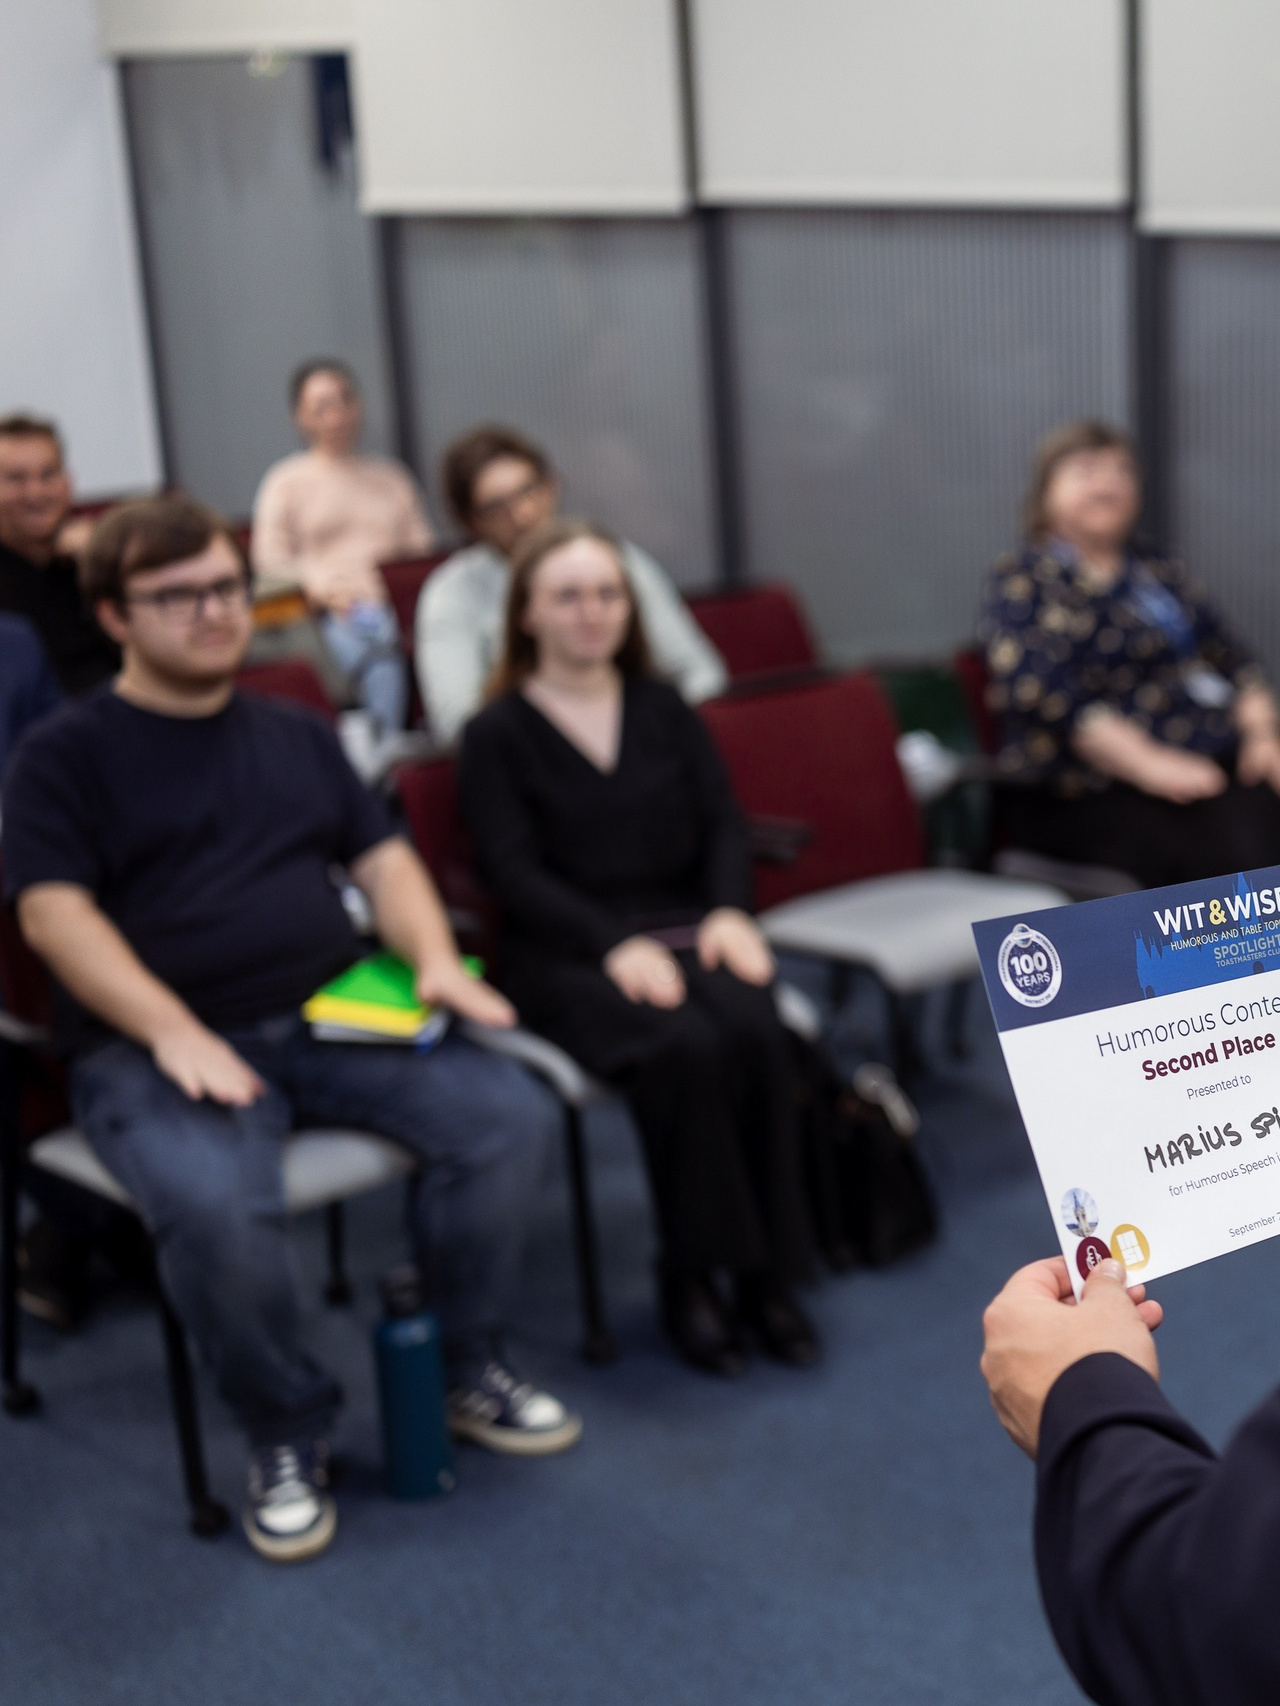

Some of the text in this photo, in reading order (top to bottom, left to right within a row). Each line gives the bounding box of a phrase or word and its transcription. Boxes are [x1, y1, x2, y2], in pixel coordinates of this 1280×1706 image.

[1170, 932, 1219, 951] HUMOROUS
[1221, 928, 1239, 940] AND
[1240, 922, 1263, 938] TABLE
[1010, 951, 1048, 976] 100
[1216, 951, 1267, 968] TOASTMASTERS
[1015, 971, 1051, 988] YEARS
[1096, 1012, 1216, 1057] Humorous
[1142, 1032, 1276, 1080] Second Place
[1186, 1073, 1252, 1100] Presented to
[1169, 1183, 1185, 1197] for
[1186, 1167, 1239, 1192] Humorous
[1239, 1155, 1276, 1177] Speech
[1228, 1215, 1276, 1239] September
